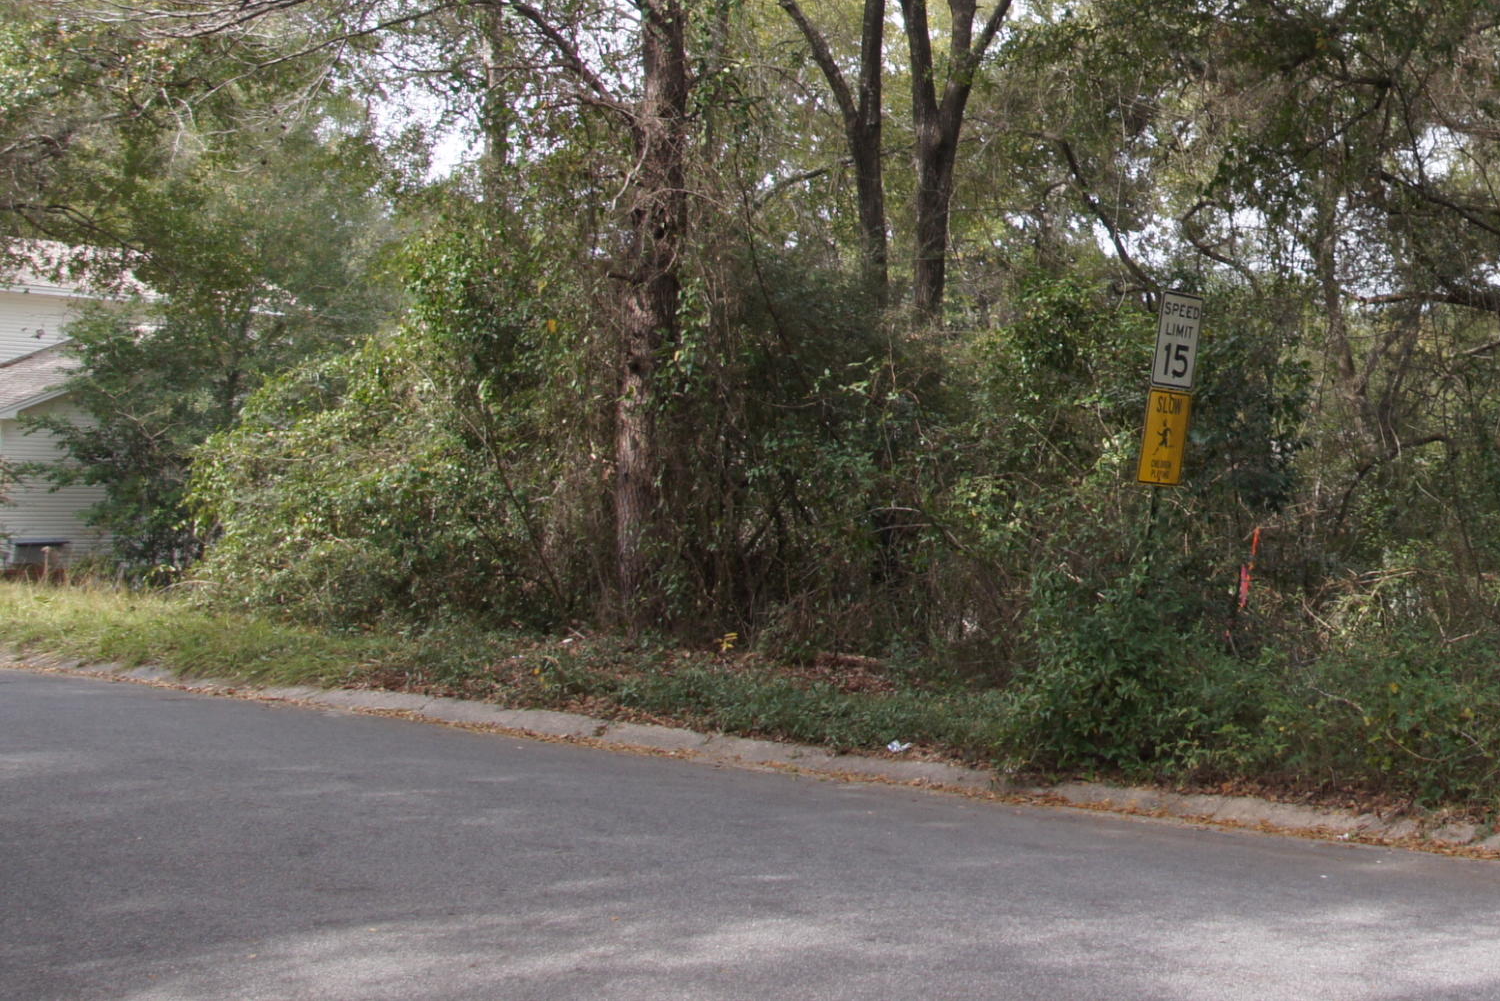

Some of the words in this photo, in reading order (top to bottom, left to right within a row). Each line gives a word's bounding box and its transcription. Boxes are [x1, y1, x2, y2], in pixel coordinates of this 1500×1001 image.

[1164, 302, 1200, 320] SPEED
[1166, 323, 1194, 339] LIMIT
[1164, 343, 1189, 378] 15
[1156, 396, 1183, 415] SLOW
